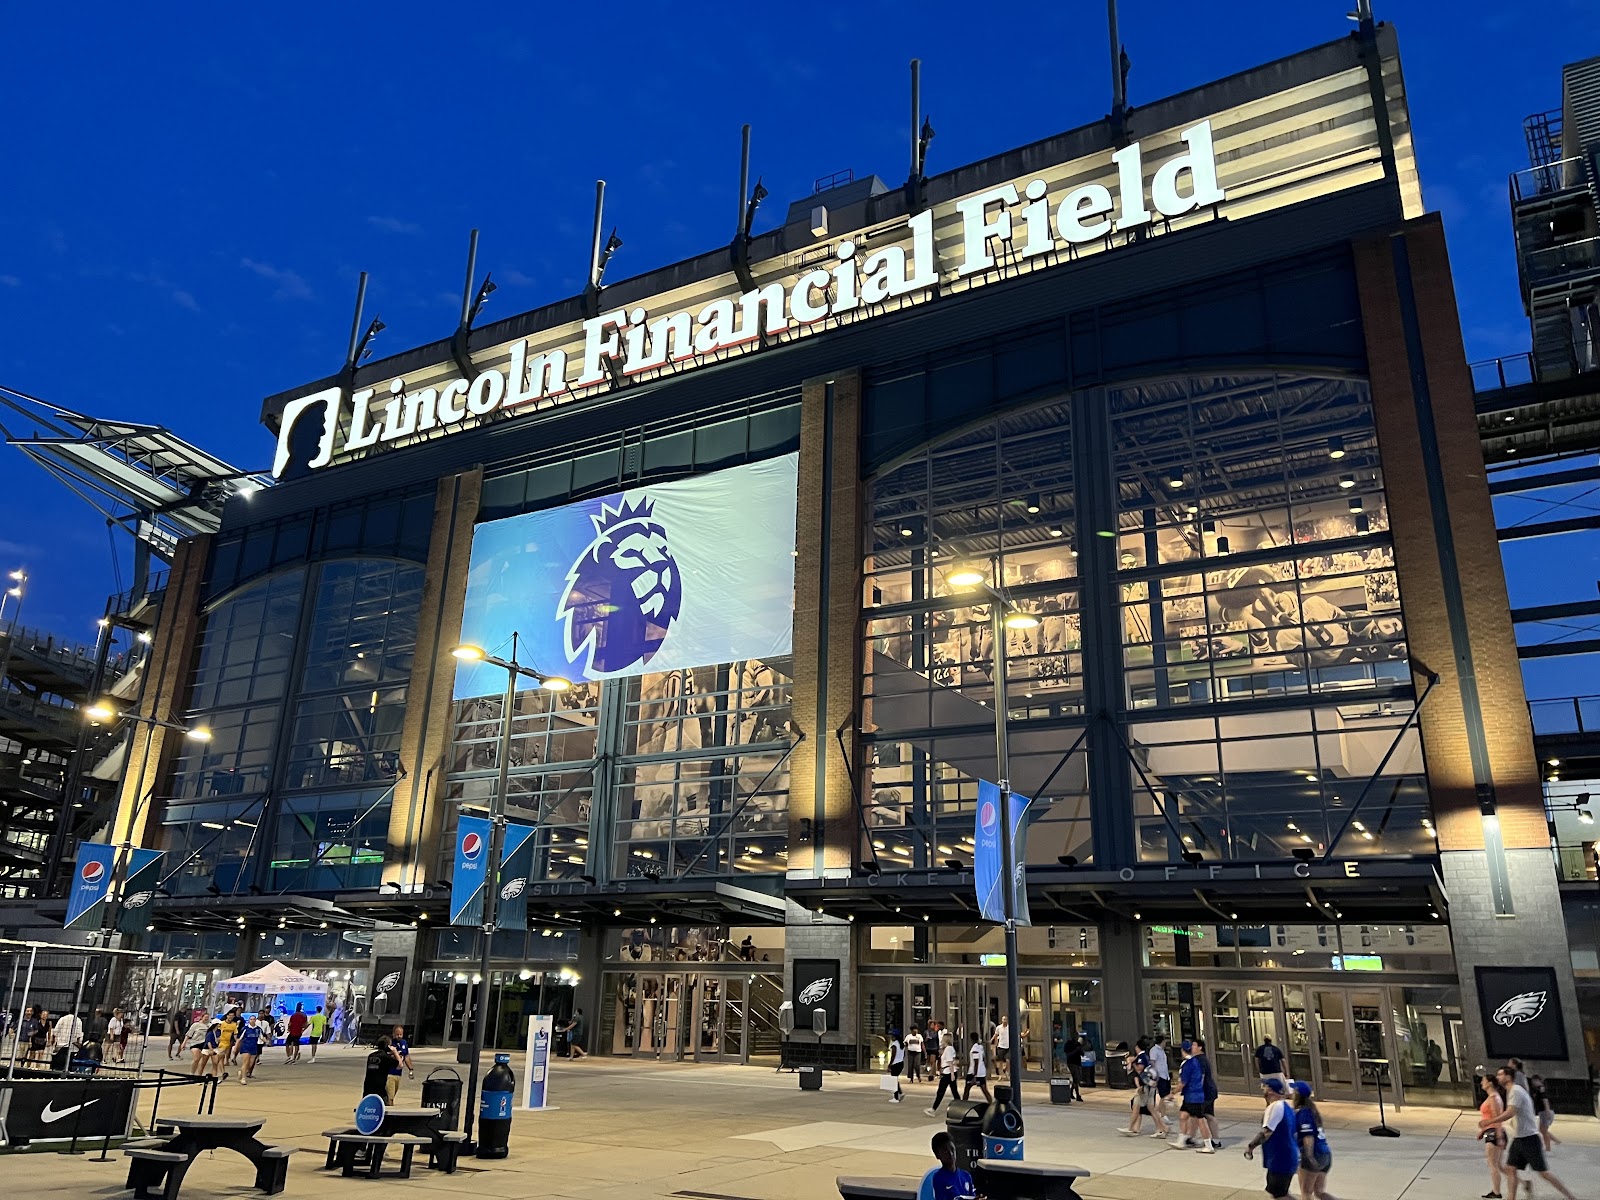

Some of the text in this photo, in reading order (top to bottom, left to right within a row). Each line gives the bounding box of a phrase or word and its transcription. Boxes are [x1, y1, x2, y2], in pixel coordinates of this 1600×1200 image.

[344, 119, 1226, 452] Lincoln Financial Field
[462, 862, 478, 870] pepsi
[1120, 861, 1361, 882] OFFICE
[80, 884, 100, 892] pepsi
[534, 881, 627, 896] SUITES
[358, 1113, 380, 1122] Painting
